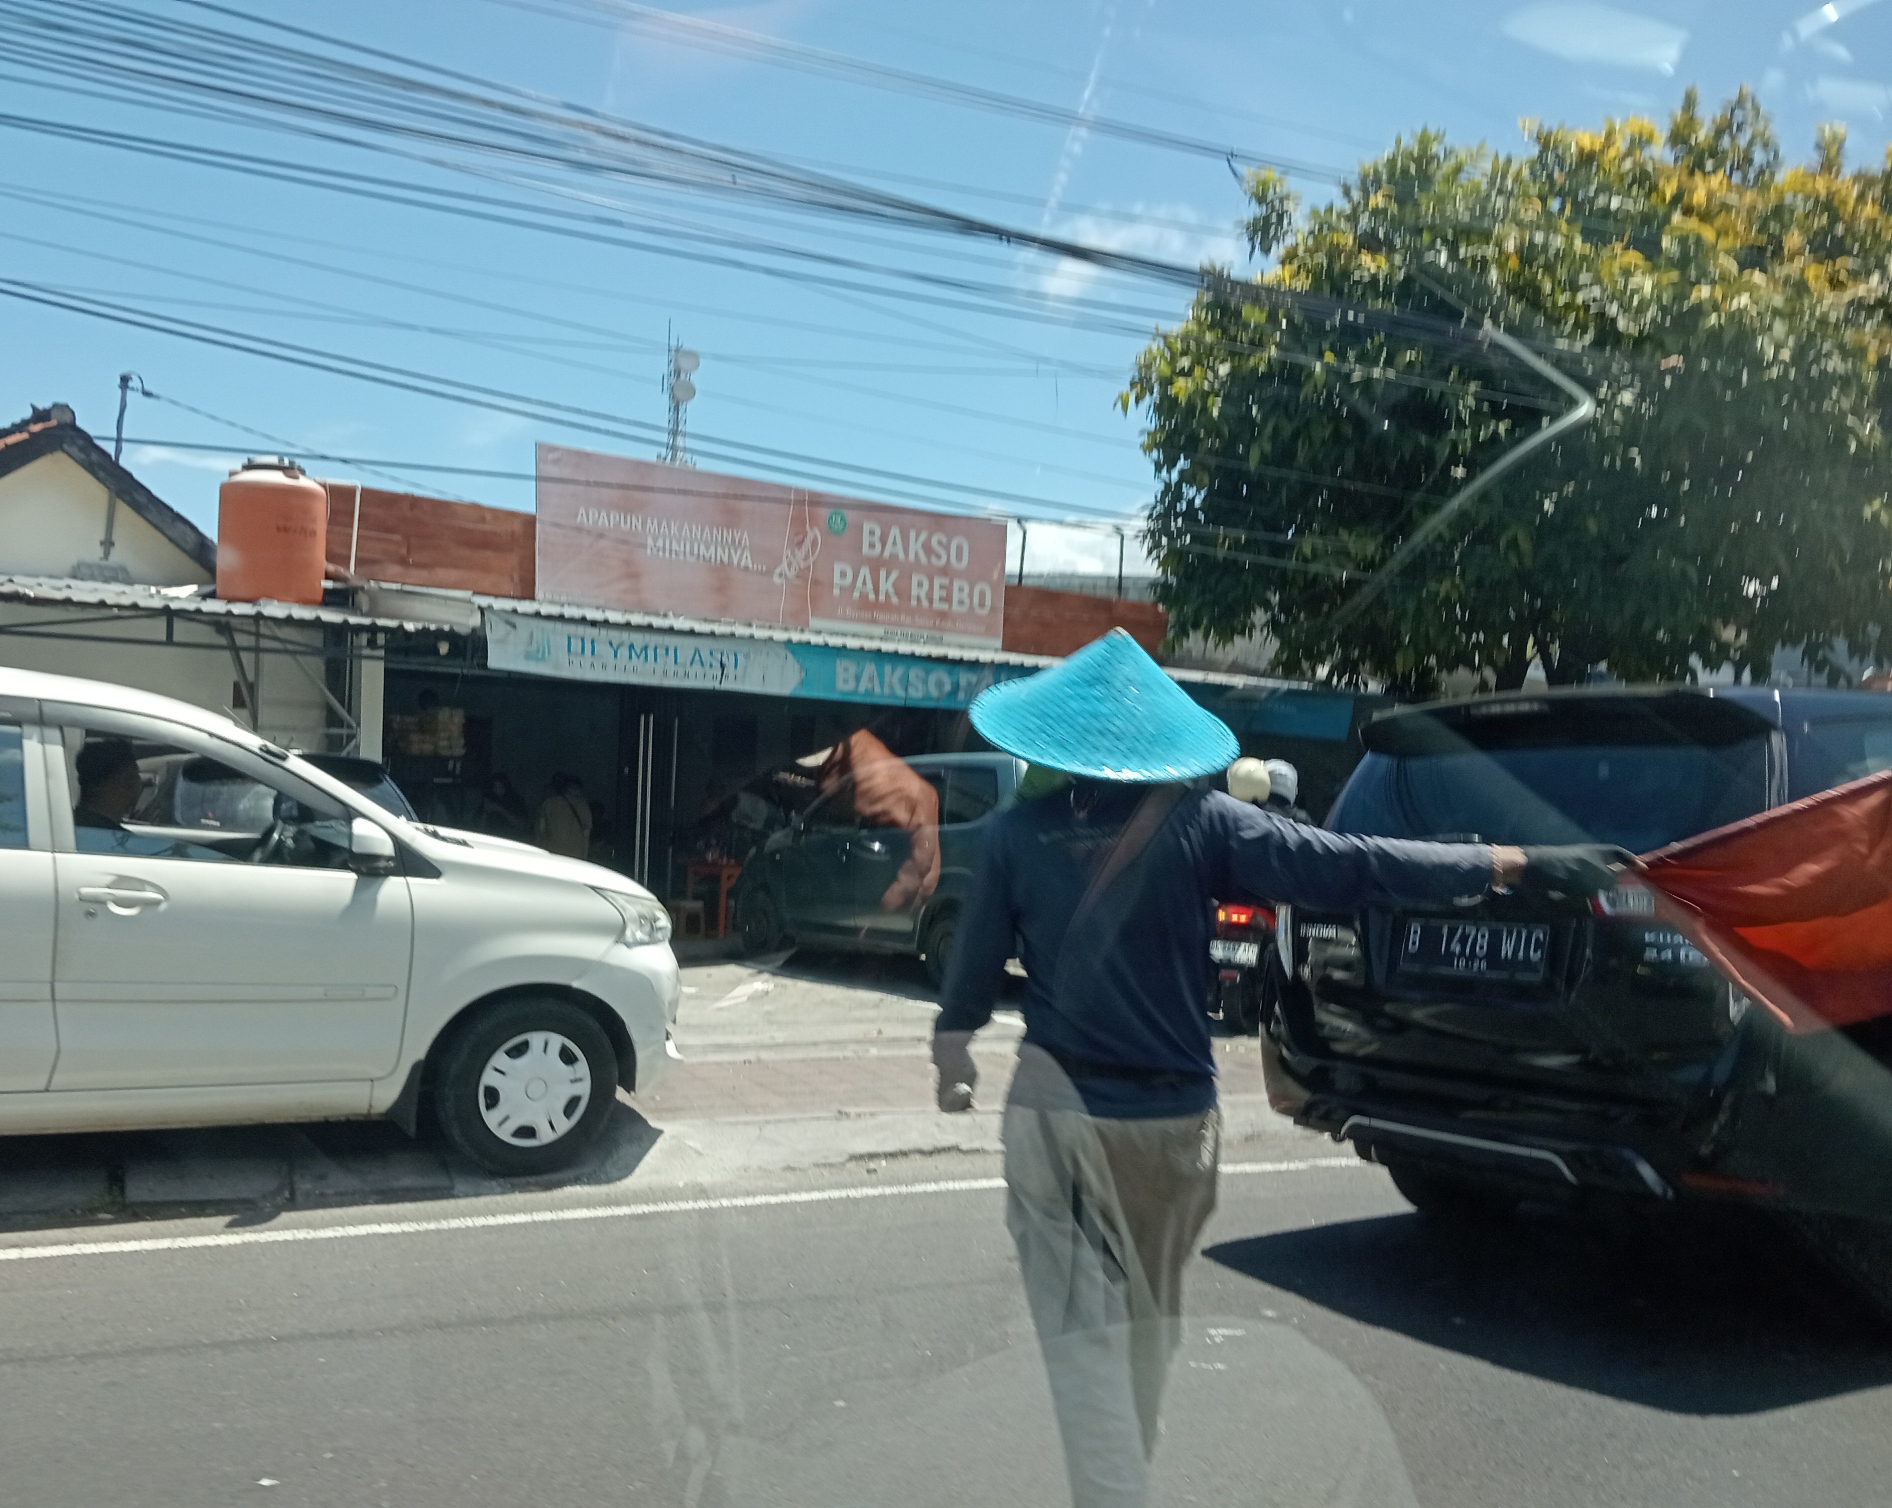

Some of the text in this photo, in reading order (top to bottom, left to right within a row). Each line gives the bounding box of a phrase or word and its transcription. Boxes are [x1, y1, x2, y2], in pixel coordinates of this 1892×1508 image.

[576, 506, 750, 547] APAPUN MAKANANNYA
[862, 520, 970, 570] BAKSO
[832, 560, 993, 616] PAK REBO
[835, 657, 952, 700] BAKSO
[1408, 922, 1544, 962] B 1478 WIC
